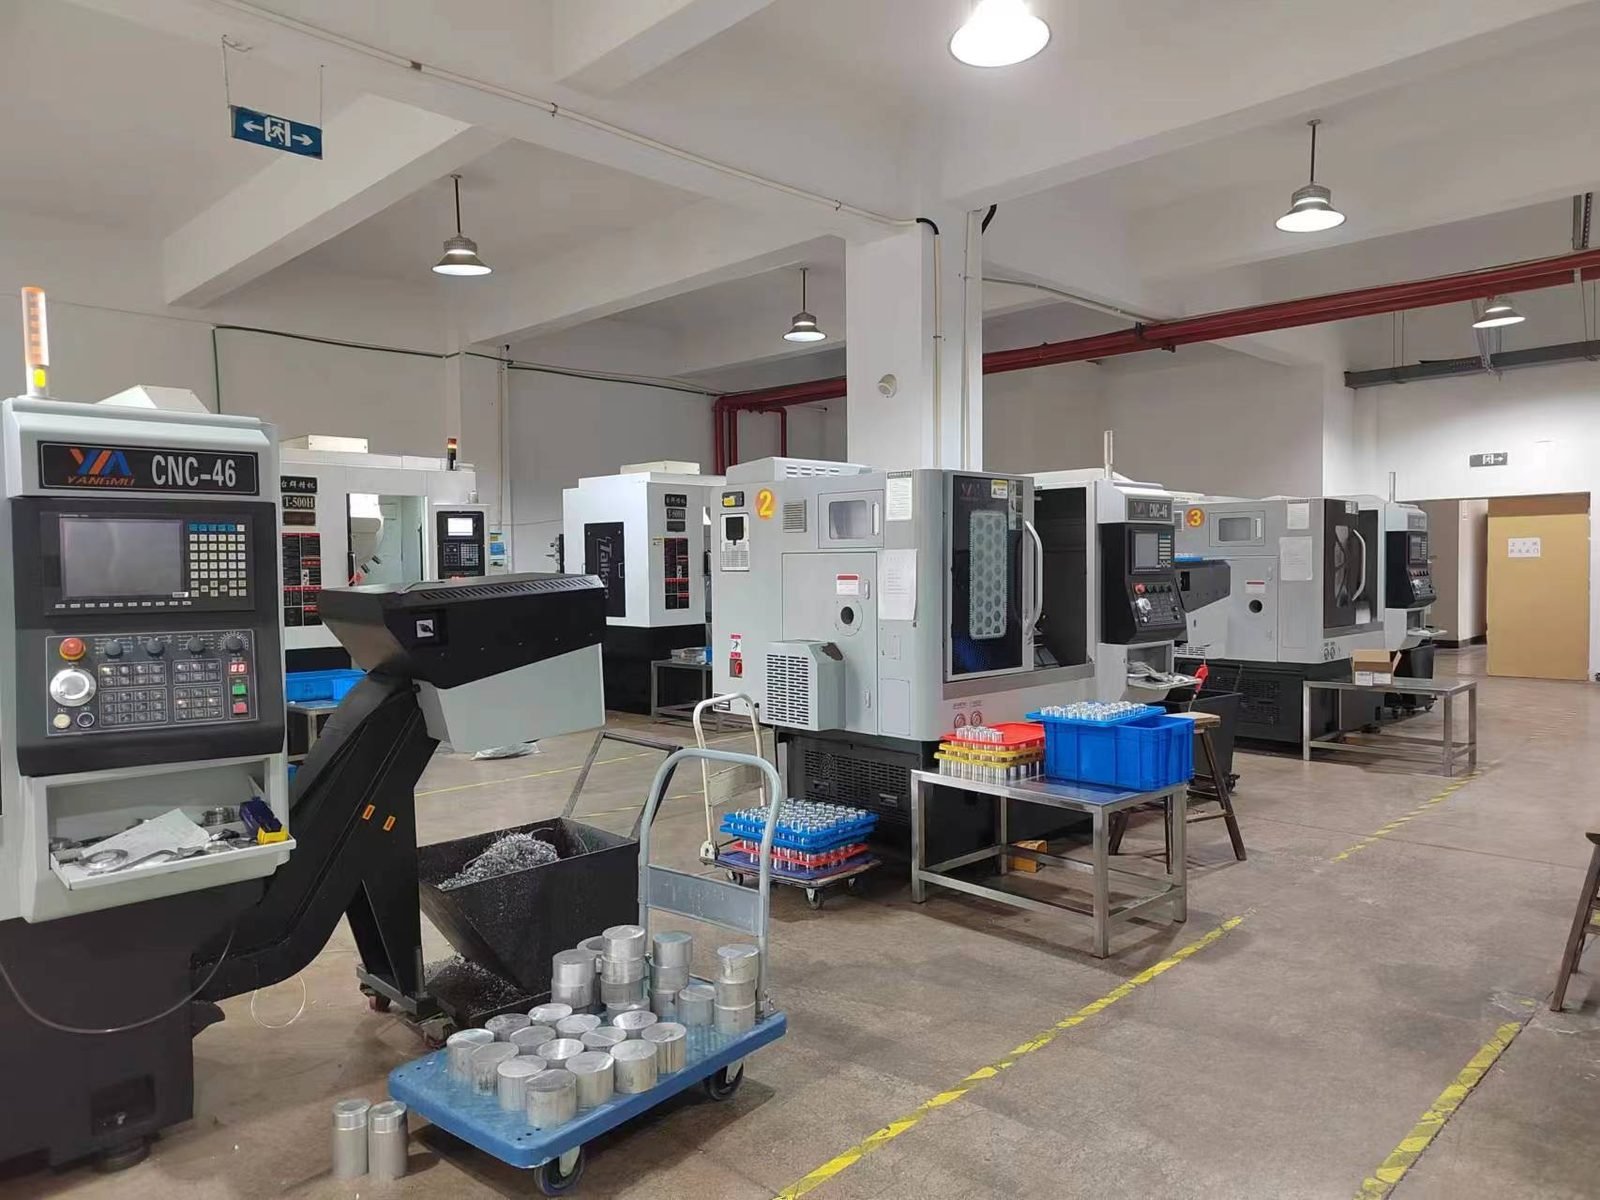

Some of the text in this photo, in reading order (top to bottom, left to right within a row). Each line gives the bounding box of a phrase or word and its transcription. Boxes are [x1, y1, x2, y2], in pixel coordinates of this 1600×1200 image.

[151, 454, 237, 488] CNC-46
[283, 496, 314, 509] T-500H
[759, 490, 774, 517] 2
[1190, 509, 1202, 527] 3
